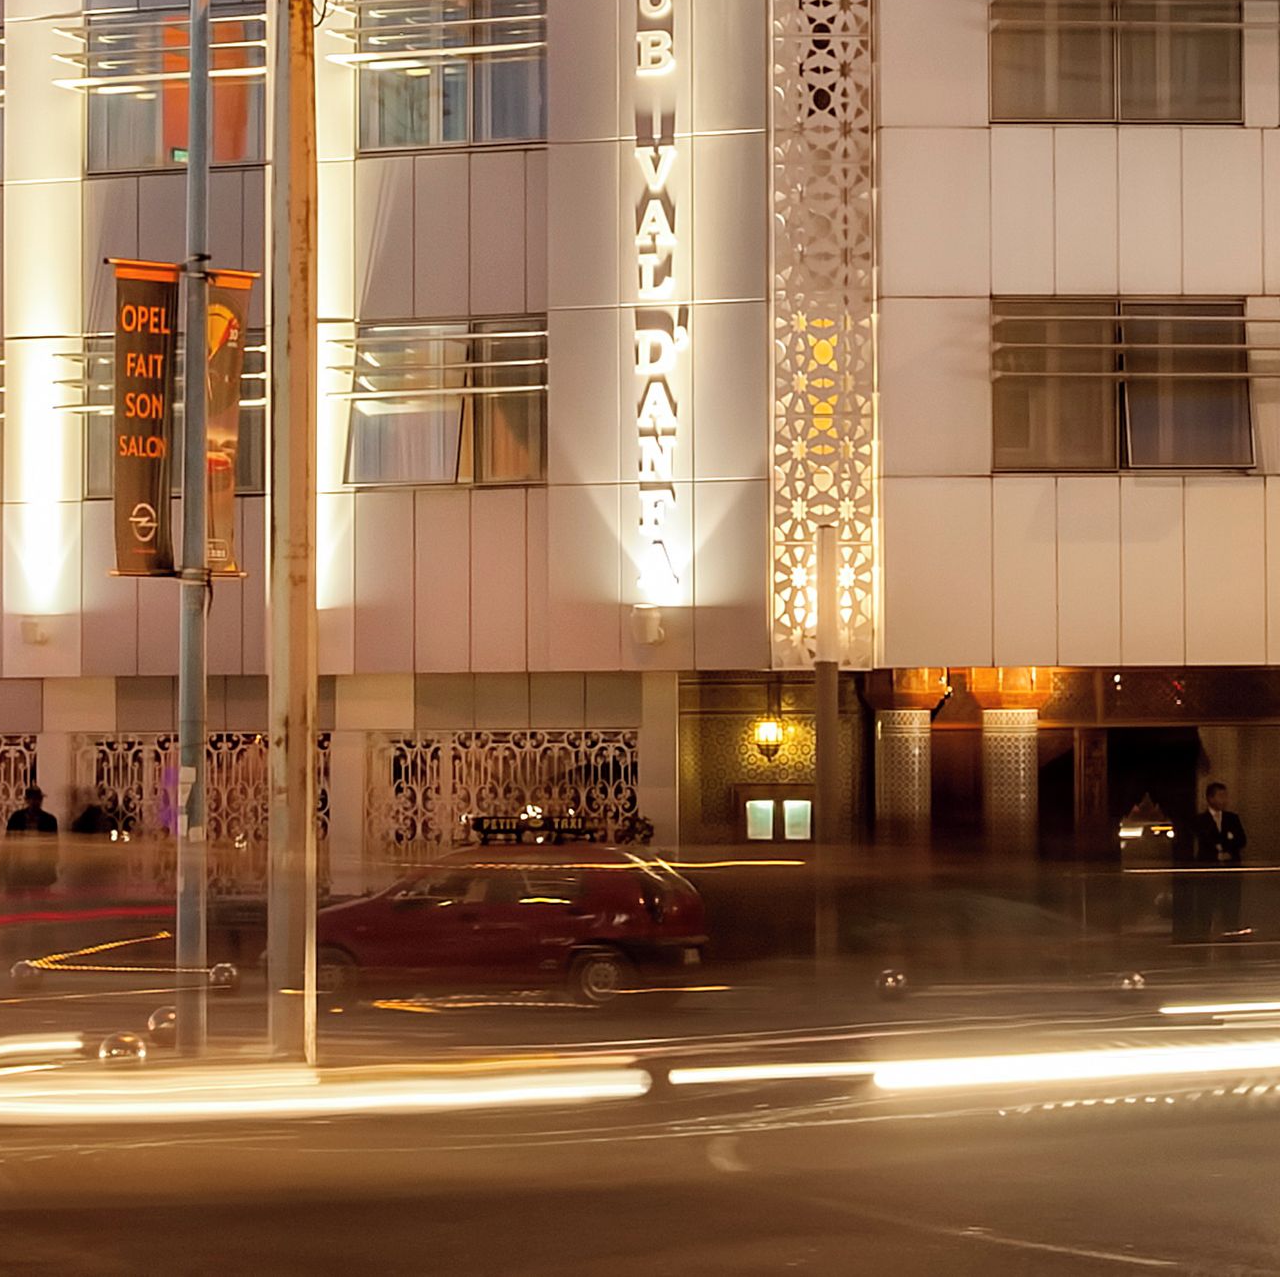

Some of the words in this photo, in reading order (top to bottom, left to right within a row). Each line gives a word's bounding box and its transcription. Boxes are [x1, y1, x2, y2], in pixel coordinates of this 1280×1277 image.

[634, 147, 678, 299] VAL
[121, 304, 169, 335] OPEL
[126, 353, 164, 379] FAIT
[125, 393, 163, 420] SON
[120, 435, 166, 459] SALON
[483, 818, 517, 829] PETIT
[553, 818, 582, 830] TAXI
